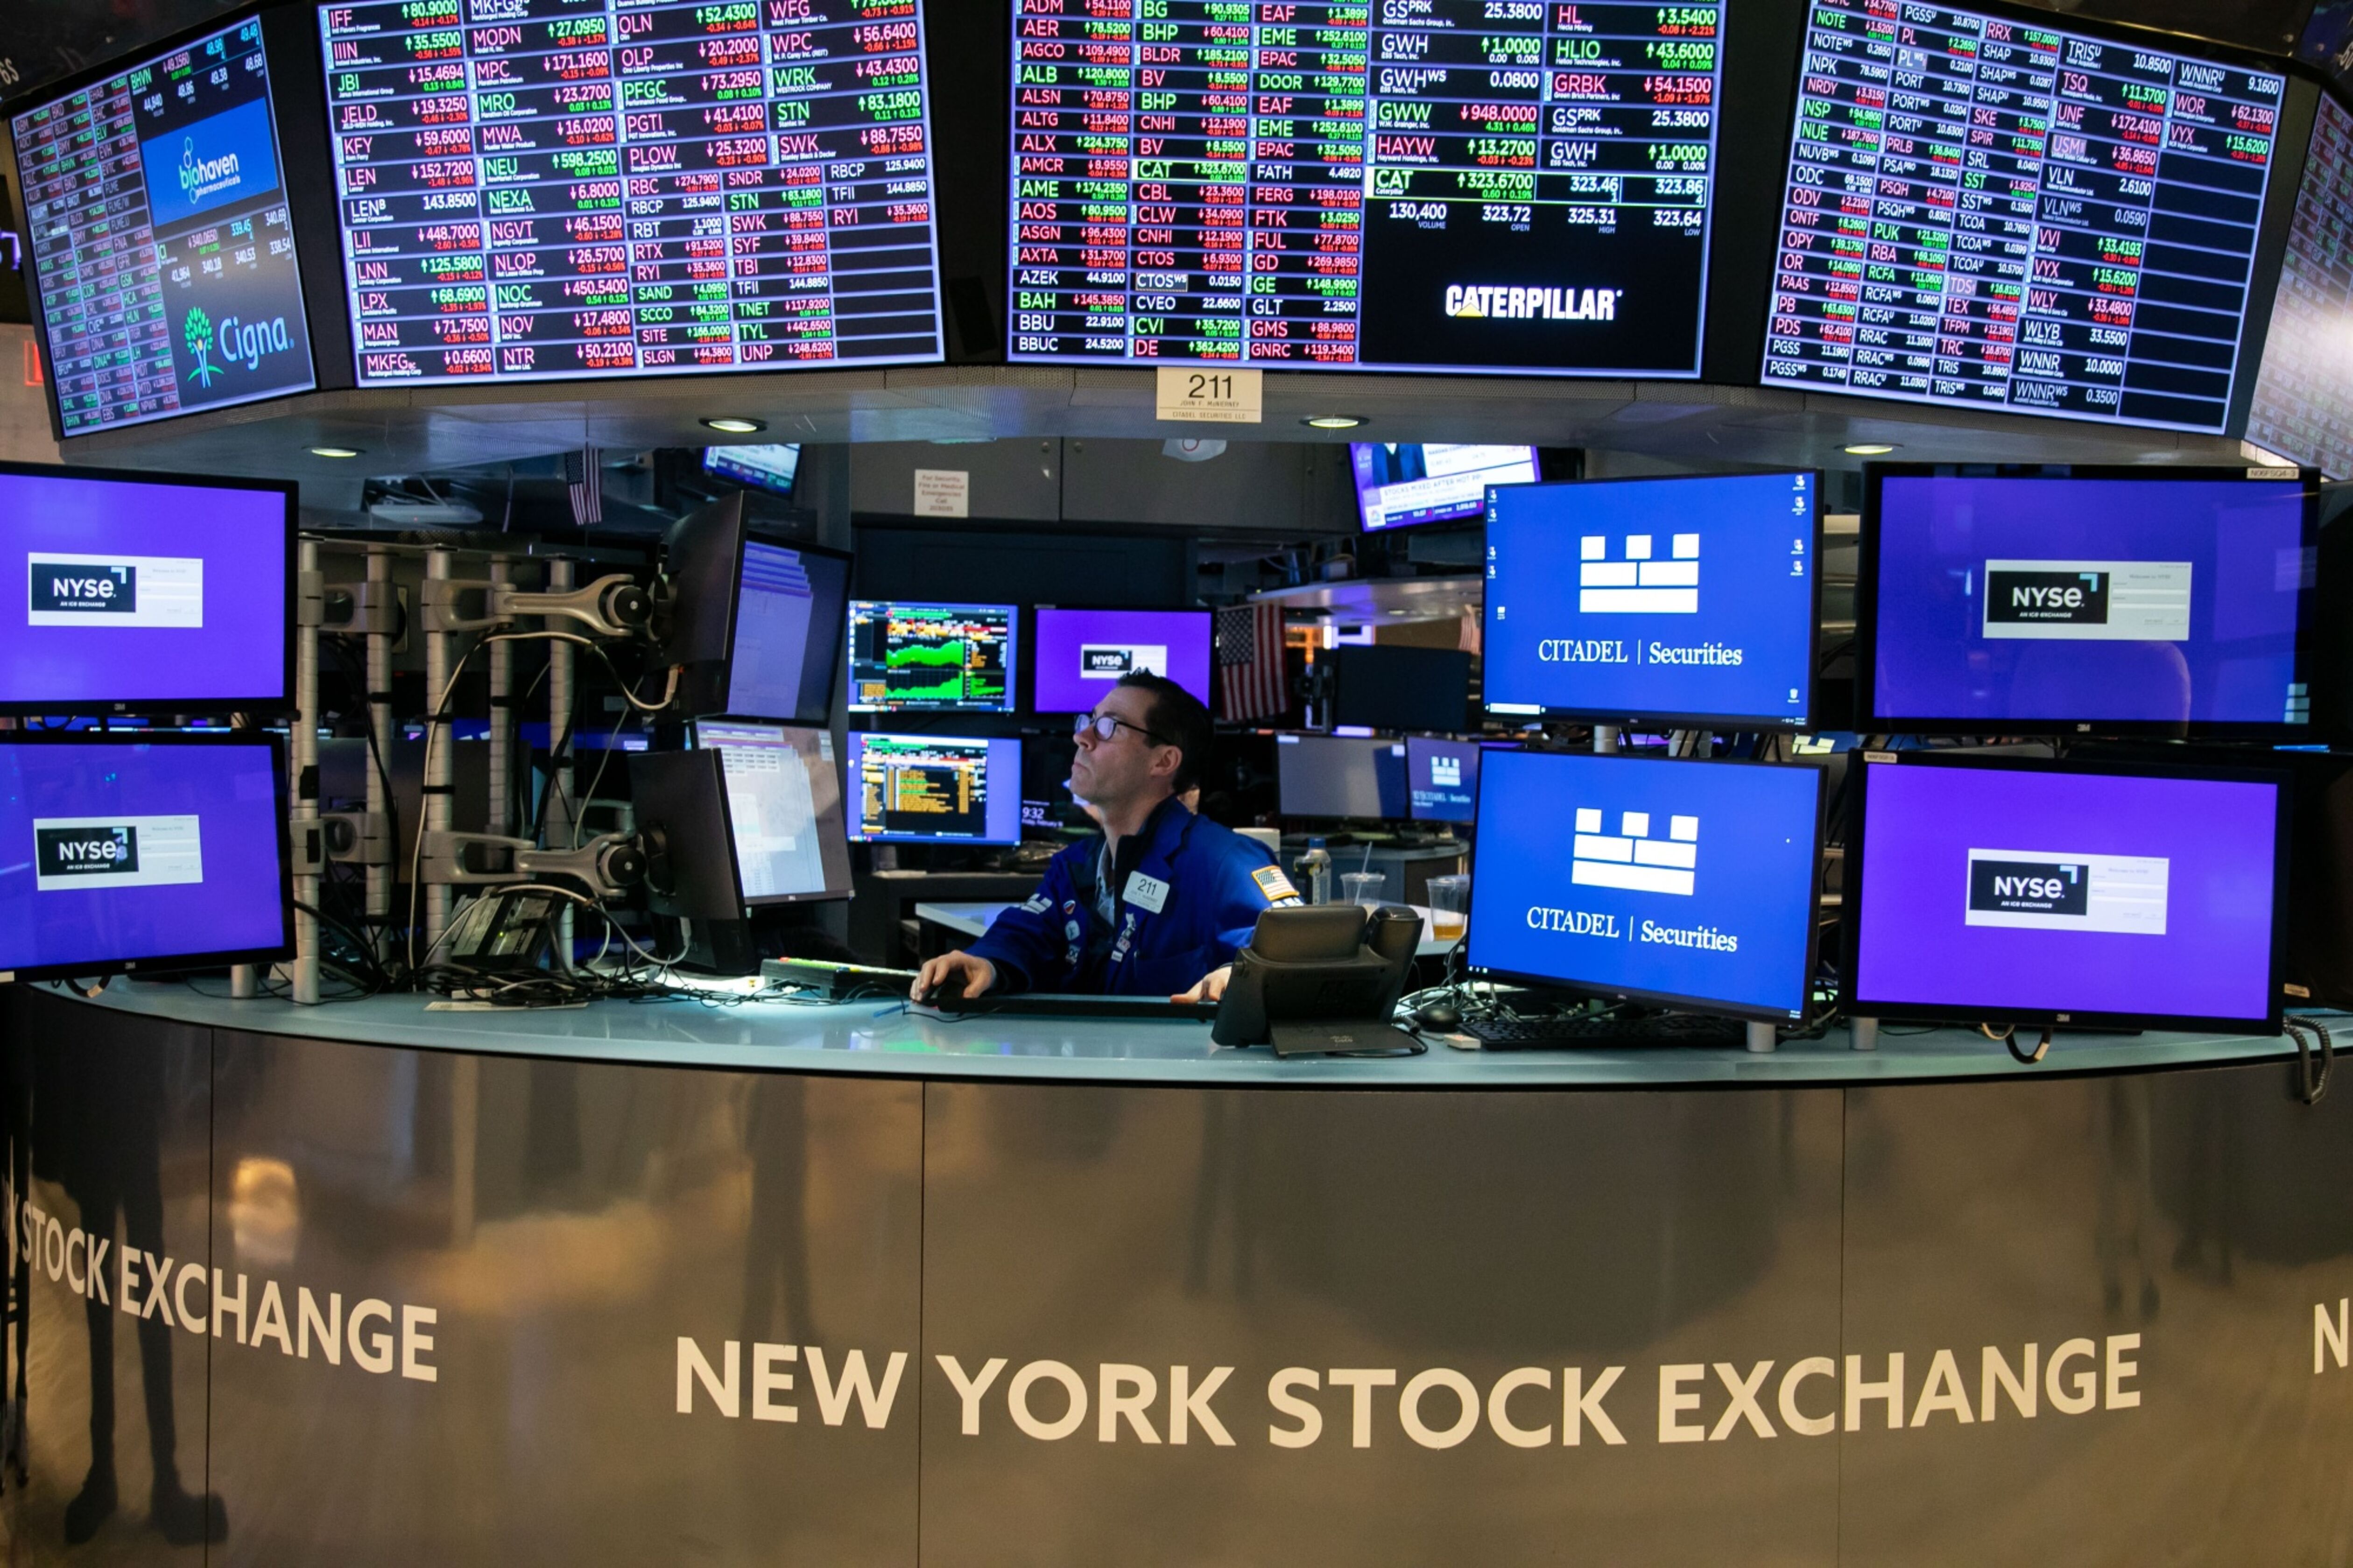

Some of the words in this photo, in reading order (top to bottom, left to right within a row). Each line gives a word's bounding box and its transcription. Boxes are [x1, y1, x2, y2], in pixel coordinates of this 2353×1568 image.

[619, 14, 652, 33] OLN
[705, 6, 755, 23] 52.4300
[1558, 6, 1582, 23] HL
[1668, 8, 1716, 25] 3.5400
[1817, 11, 1846, 28] NOTE
[1870, 22, 1894, 35] 1.5200
[473, 28, 521, 47] MODN
[557, 18, 605, 36] 27.0950
[1024, 21, 1059, 36] AER
[1091, 22, 1130, 34] 78.5200
[1143, 24, 1178, 41] BHP
[1209, 26, 1248, 39] 60.4100
[1556, 42, 1600, 57] HLIO
[1655, 44, 1713, 59] 43.6000
[477, 61, 510, 78] MPC
[552, 51, 608, 70] 171.1600
[775, 67, 816, 85] WRK
[866, 57, 918, 75] 43.4300
[1811, 56, 1837, 75] NPK
[1860, 65, 1888, 78] 78.5900
[338, 75, 359, 92] JBI
[417, 64, 464, 82] 15.4694
[1260, 75, 1302, 89] DOOR
[1321, 76, 1365, 88] 129.7700
[1555, 75, 1606, 92] GRBK
[1654, 77, 1711, 93] 54.1500
[1895, 72, 1923, 89] PORT
[2064, 71, 2088, 92] TSQ
[2128, 85, 2166, 103] 11.3700
[1022, 91, 1061, 105] ALSN
[1089, 91, 1128, 103] 70.8750
[2176, 94, 2205, 113] WOR
[2237, 105, 2274, 124] 62.1300
[341, 105, 377, 123] JELD
[420, 97, 467, 113] 19.3250
[1379, 104, 1431, 121] GWW
[1471, 105, 1537, 121] 948.0000
[780, 135, 818, 153] SWK
[870, 126, 922, 143] 88.7550
[1377, 137, 1435, 155] HAYW
[1478, 140, 1535, 156] 13.2700
[630, 146, 676, 164] PLOW
[716, 139, 766, 156] 25.3200
[178, 153, 239, 190] biohaven
[1376, 170, 1413, 188] CAT
[1468, 173, 1533, 190] 323.6700
[2049, 167, 2074, 186] VLN
[2120, 179, 2151, 196] 2.6100
[1571, 176, 1618, 191] 323.46
[1656, 179, 1703, 194] 323.86
[1389, 204, 1446, 220] 130,400
[1482, 206, 1531, 222] 323.72
[1568, 209, 1616, 224] 325.31
[1653, 211, 1701, 227] 323.64
[1418, 221, 1446, 229] VOLUME
[2039, 228, 2060, 247] VVI
[2105, 239, 2142, 256] 33.4193
[358, 262, 387, 279] LNN
[430, 256, 482, 273] 125.5800
[1020, 270, 1058, 285] AZEK
[1087, 273, 1125, 284] 44.9100
[498, 285, 532, 302] NOC
[573, 279, 627, 295] 450.5400
[1136, 296, 1176, 309] CVEO
[1203, 297, 1241, 309] 22.6600
[1252, 299, 1282, 315] GLT
[1324, 301, 1356, 313] 2.2500
[1446, 285, 1615, 320] CATERPILLAR
[364, 323, 397, 341] MAN
[443, 318, 488, 334] 71.7500
[740, 324, 768, 340] TYL
[2025, 320, 2060, 339] WLYB
[2090, 328, 2127, 346] 33.5500
[1019, 336, 1058, 351] BBUC
[1085, 338, 1124, 350] 24.5200
[2021, 351, 2059, 370] WNNR
[2085, 358, 2122, 375] 10.0000
[1189, 374, 1231, 399] 211
[1539, 640, 1628, 662] CITADEL
[1649, 641, 1742, 666] Securities
[1137, 879, 1157, 895] 211
[1527, 907, 1620, 938] CITADEL
[1641, 921, 1738, 953] Securities
[22, 1201, 109, 1306] STOCK
[121, 1245, 437, 1382] EXCHANGE
[676, 1336, 908, 1428] NEW
[935, 1355, 1236, 1446] YORK
[1268, 1367, 1627, 1448] STOCK
[1658, 1333, 2141, 1443] EXCHANGE
